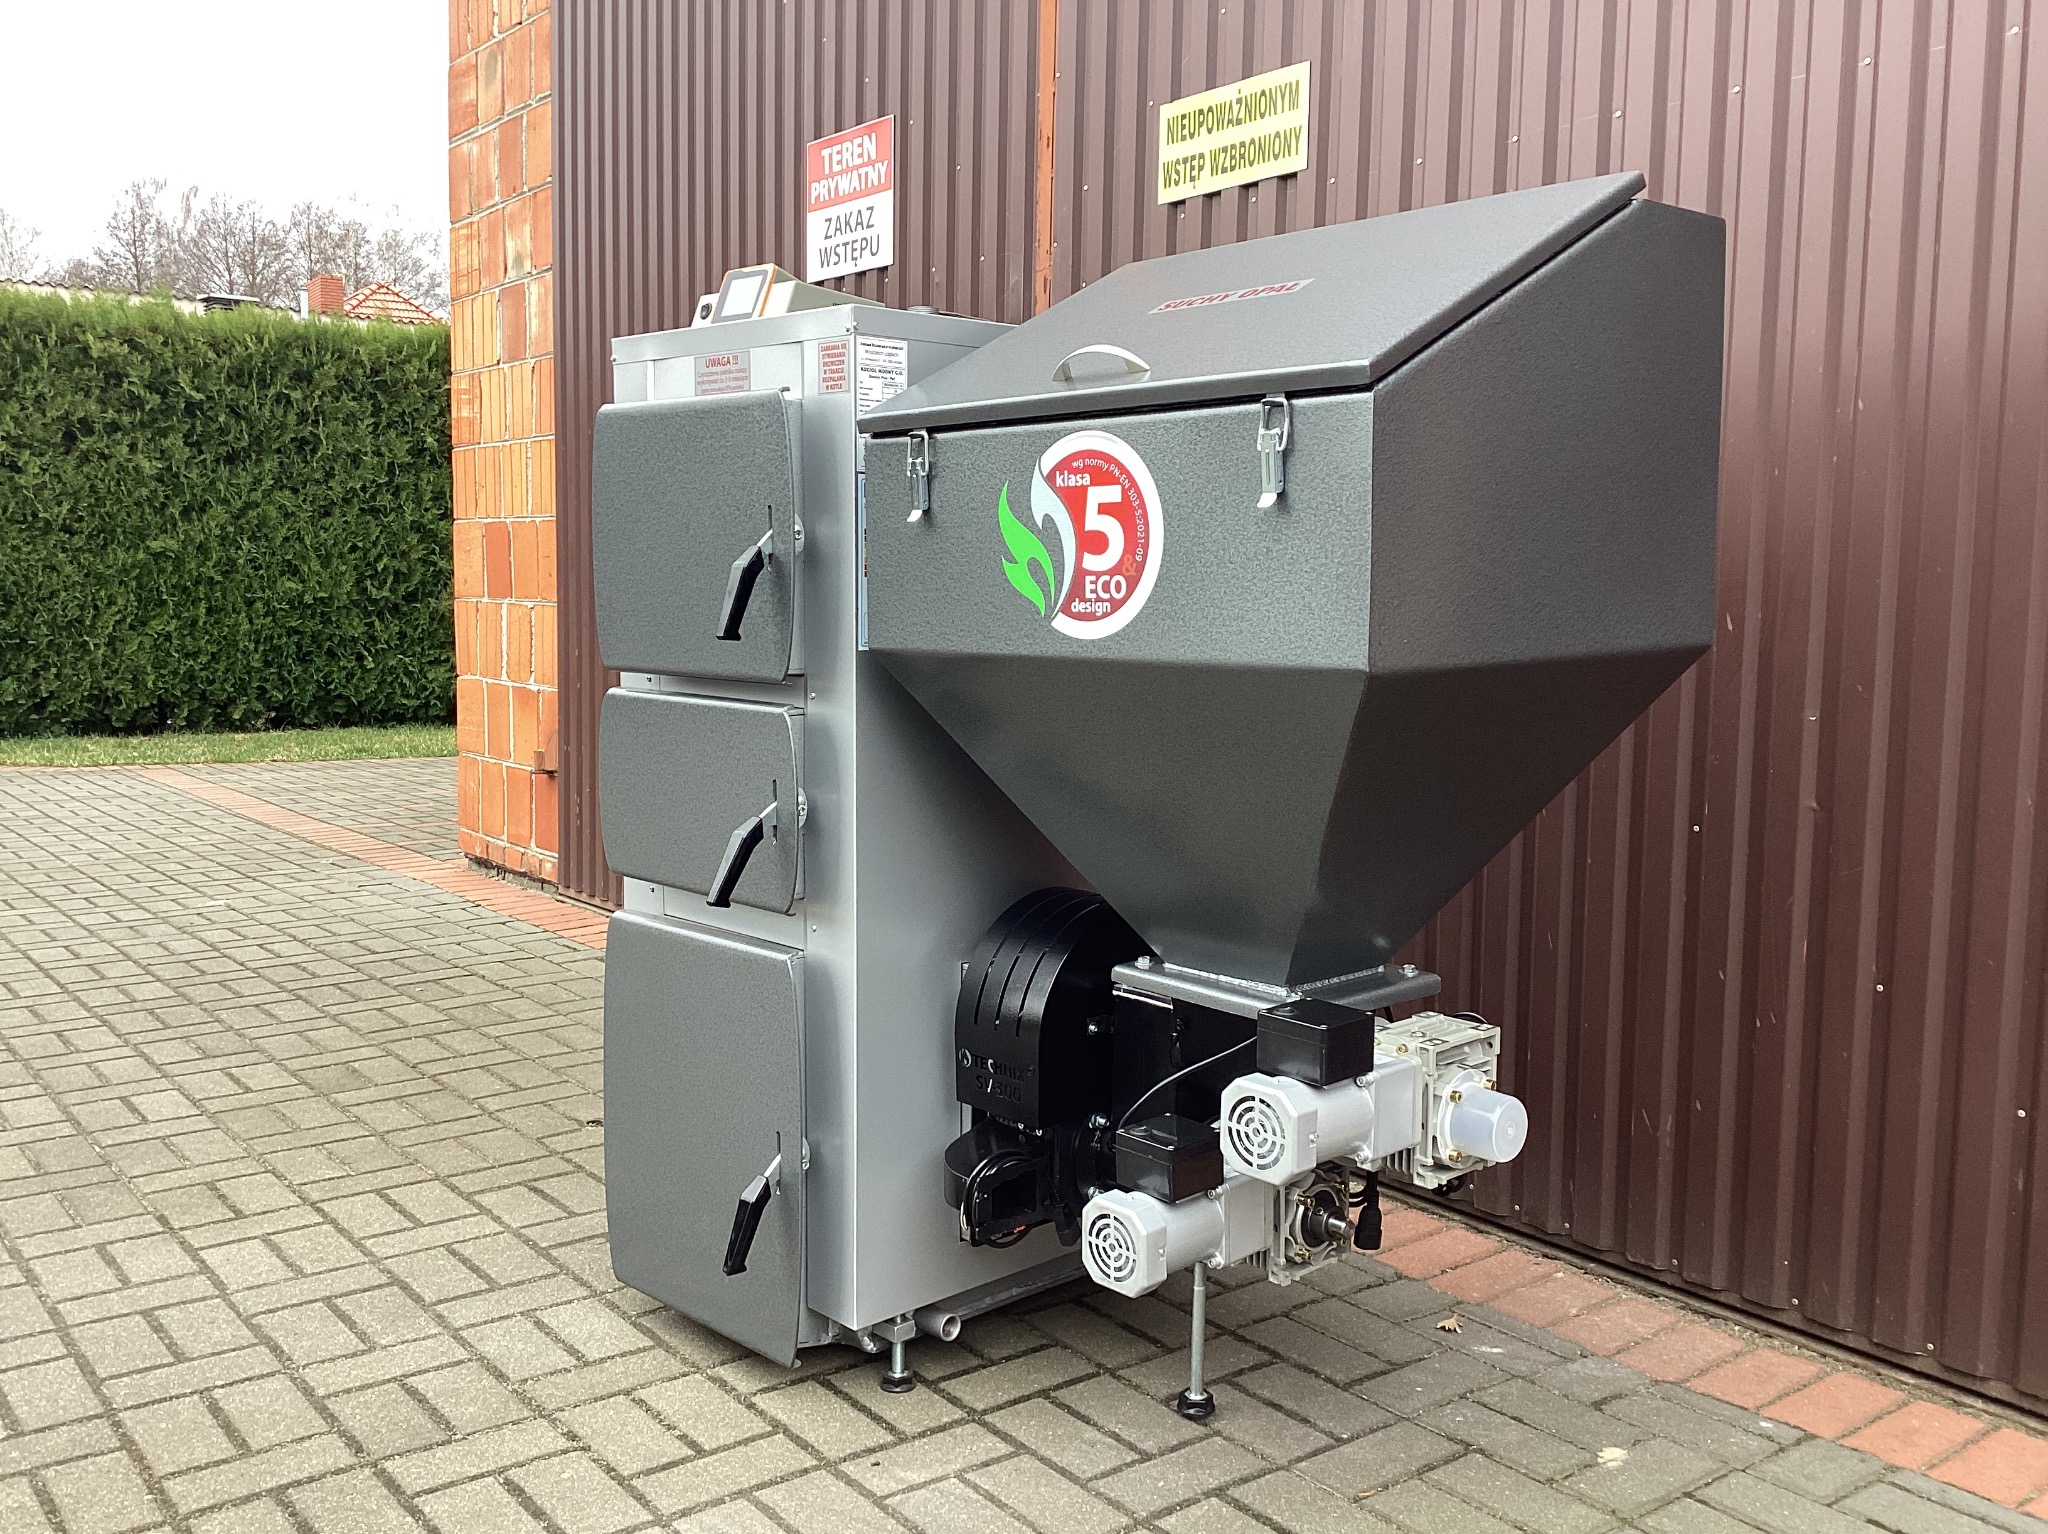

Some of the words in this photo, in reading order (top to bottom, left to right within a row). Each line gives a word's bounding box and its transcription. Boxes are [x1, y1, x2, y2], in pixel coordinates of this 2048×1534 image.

[1166, 79, 1300, 146] NIEUPOWAŻNIONYM
[820, 131, 877, 176] TEREN
[1162, 151, 1206, 190] WSTĘP
[1209, 125, 1303, 177] WZBRONIONY
[810, 159, 889, 205] PRYWATNY
[823, 205, 875, 241] ZAKAZ
[818, 233, 880, 269] WSTĘPU
[1157, 292, 1237, 311] SUCHY
[704, 356, 731, 369] UWAGA
[1055, 470, 1091, 487] klasa
[1071, 458, 1084, 469] wg
[1084, 458, 1110, 471] normy
[1108, 463, 1131, 489] PN-EN
[1127, 487, 1145, 562] 303-5:2021-09
[1081, 484, 1125, 572] 5
[1085, 574, 1127, 599] ECO
[1070, 598, 1111, 616] design
